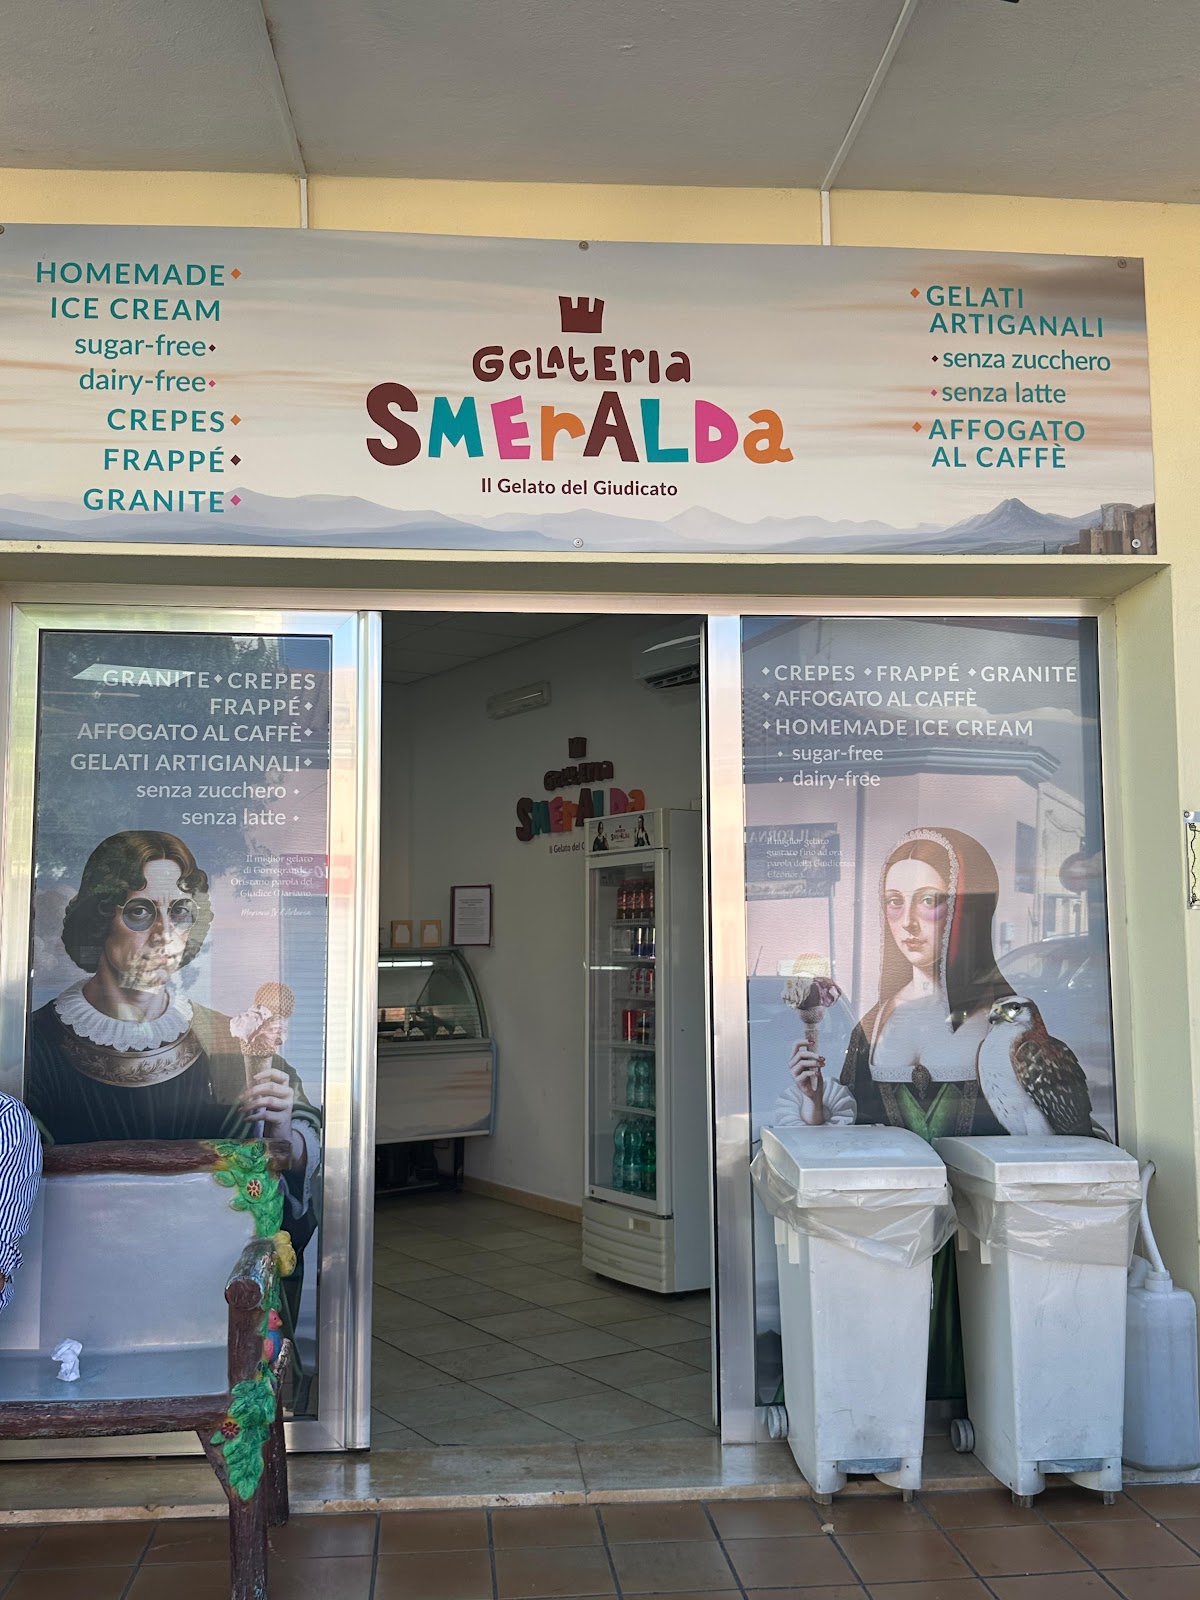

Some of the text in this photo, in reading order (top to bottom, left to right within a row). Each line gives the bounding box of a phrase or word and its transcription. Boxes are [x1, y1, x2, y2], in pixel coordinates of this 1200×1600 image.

[36, 261, 225, 286] HOMEMADE
[926, 285, 1024, 308] GELATI
[50, 297, 221, 321] ICE CREAM
[929, 312, 1104, 338] ARTIGANALI
[74, 334, 207, 359] sugar-free
[943, 350, 1111, 371] senza zucchero
[79, 368, 206, 395] dairy-free
[942, 382, 1066, 403] senza latte
[106, 408, 225, 433] CREPES
[928, 419, 1085, 441] AFFOGATO
[103, 446, 225, 473] FRAPPÉ
[931, 443, 1066, 469] AL CAFFÈ
[481, 478, 678, 496] Il Gelato del Giudicato
[83, 488, 225, 513] GRANITE
[103, 669, 316, 690] GRANITE CREPES
[774, 662, 1078, 683] CREPES FRAPPÉ GRANITE
[210, 696, 300, 716] FRAPPÉ
[775, 688, 977, 707] AFFOGATO AL CAFFÈ
[77, 722, 302, 742] AFFOGATO AL CAFFÈ
[776, 719, 1033, 736] HOMEMADE ICE CREAM
[70, 753, 300, 772] GELATI ARTIGIANALI
[792, 746, 883, 764] sugar-free
[793, 770, 881, 789] dairy-free
[137, 782, 287, 799] senza zucchero
[181, 808, 286, 826] senza latte
[804, 838, 829, 847] gelato
[246, 854, 313, 865] Il miglior gelato
[766, 860, 793, 869] parola
[271, 878, 299, 887] parola
